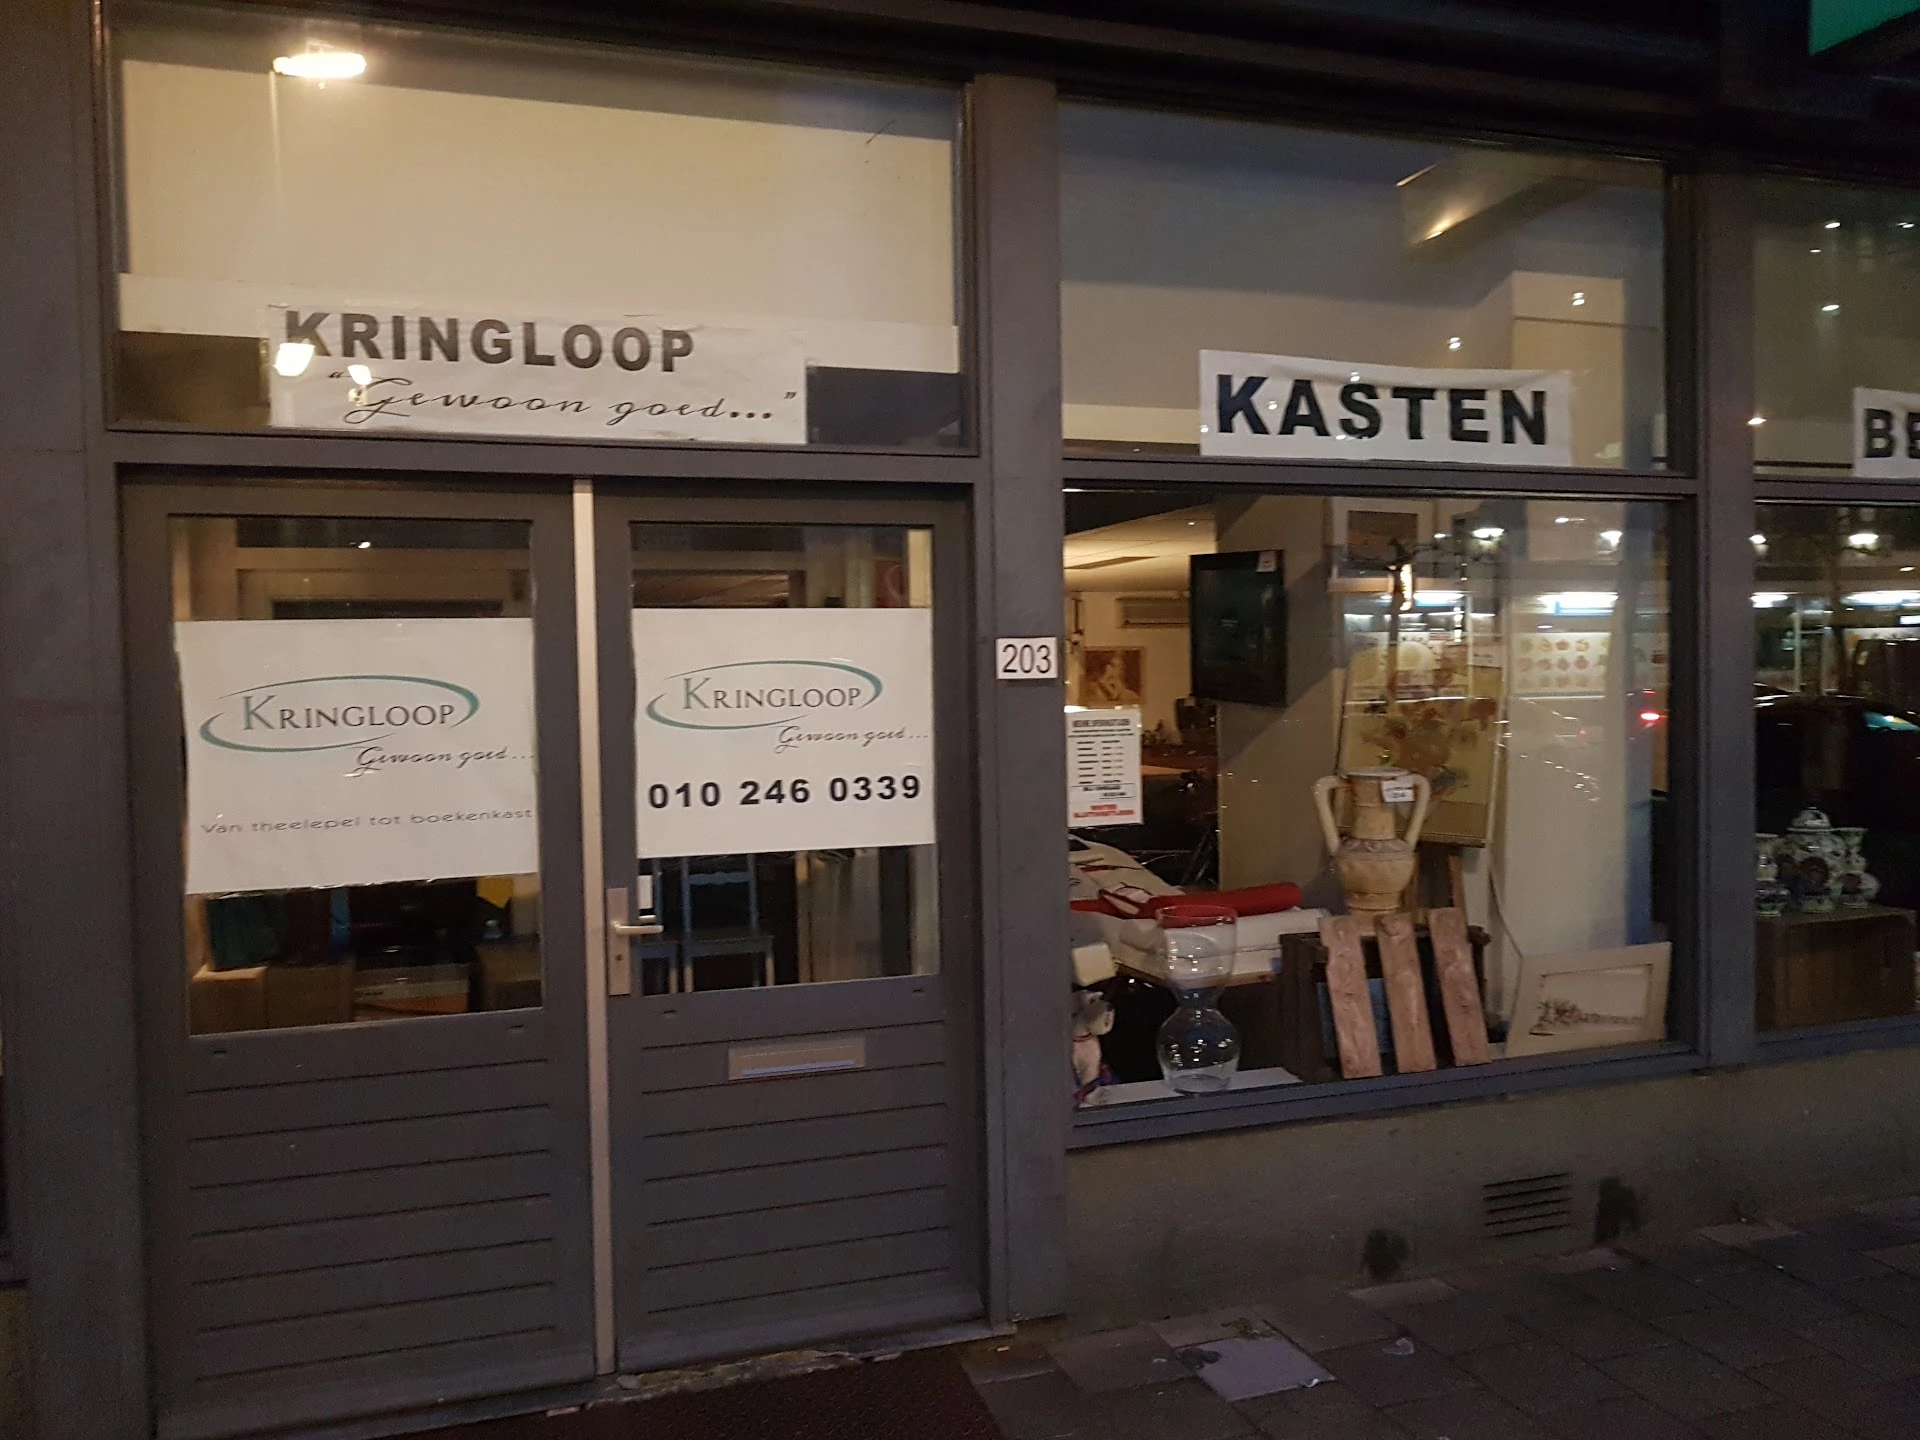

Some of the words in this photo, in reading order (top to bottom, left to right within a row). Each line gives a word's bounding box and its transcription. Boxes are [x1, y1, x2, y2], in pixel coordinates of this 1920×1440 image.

[284, 310, 692, 373] KRINGLOOP
[1217, 374, 1546, 445] KASTEN
[1002, 644, 1050, 674] 203
[682, 677, 862, 710] KRINGLOOP
[242, 695, 456, 731] KRINGLOOP
[775, 725, 858, 754] Gewoon
[346, 746, 452, 777] Gewoon
[649, 783, 720, 809] 010
[739, 779, 811, 806] 246
[829, 775, 921, 802] 0339
[251, 815, 361, 832] theelepel
[369, 815, 401, 826] tot
[410, 808, 533, 824] boekenkast
